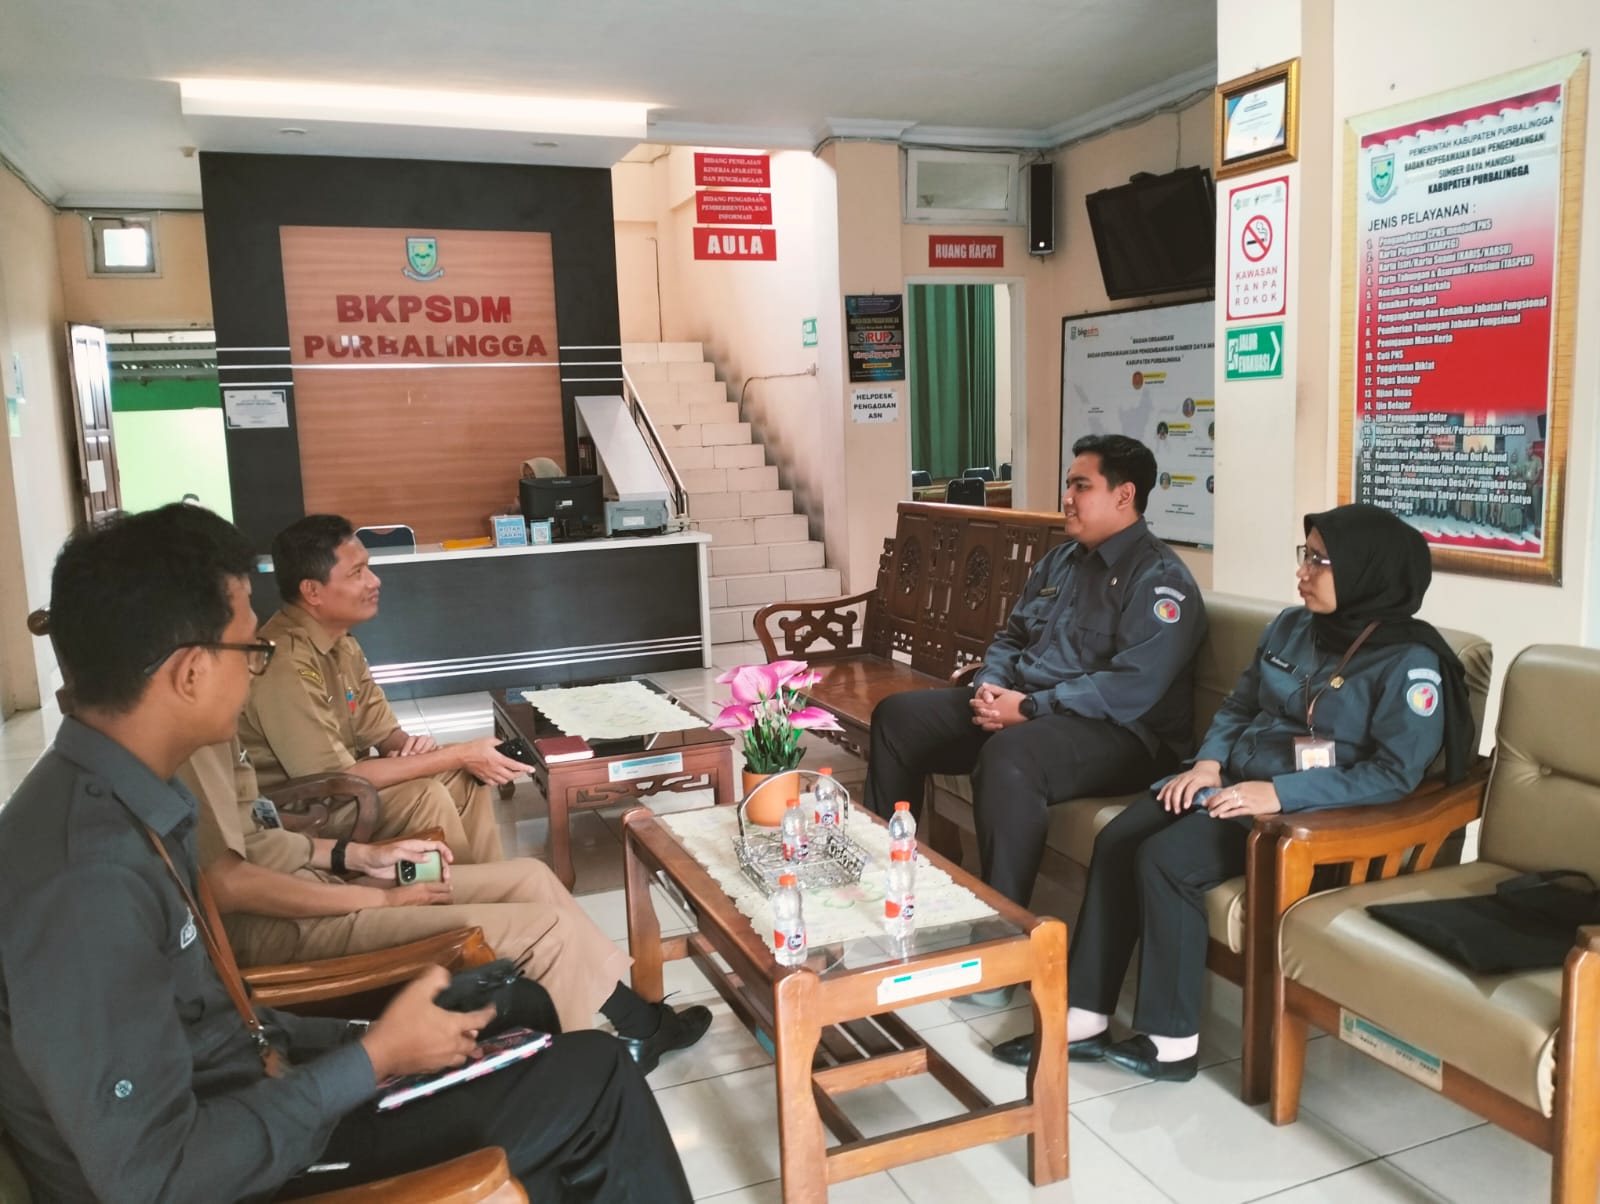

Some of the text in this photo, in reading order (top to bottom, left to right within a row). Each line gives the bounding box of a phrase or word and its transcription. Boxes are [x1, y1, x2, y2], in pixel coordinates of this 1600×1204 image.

[1408, 115, 1554, 156] PEMERINTAH KABUPATEN PURBALINGGA
[1404, 132, 1545, 172] BADAN KEPEGAWAIAN DAN PENGEMBANGAN
[1439, 155, 1515, 178] SUMBER DAYA MANUSIA
[1428, 164, 1529, 194] KABUPATEN PURBALINGGA
[1368, 203, 1469, 232] JENIS PELAYANAN
[1379, 231, 1427, 247] Pengangkatan
[1427, 227, 1446, 239] CPNS
[1446, 222, 1476, 236] menjadi
[1477, 218, 1492, 231] PNS
[707, 234, 764, 255] AULA
[935, 243, 997, 259] RUANG RAPAT
[1379, 249, 1397, 260] Kartu
[1427, 238, 1459, 252] (KARPEG)
[1379, 262, 1397, 272] Kartu
[1456, 243, 1513, 261] (KARIS/KARSU)
[1235, 266, 1278, 280] KAWASAN
[1379, 275, 1397, 285] Kartu
[1397, 270, 1430, 282] Tabungan
[1436, 263, 1468, 277] Asuransi
[1469, 260, 1501, 274] Pensiun
[1501, 254, 1534, 269] (TASPEN)
[1235, 280, 1277, 292] TANPA
[1378, 286, 1409, 298] Kenaikan
[1409, 283, 1423, 294] Gaji
[1424, 280, 1451, 292] Berkala
[1235, 293, 1277, 305] ROKOK
[1378, 300, 1409, 310] Kenaikan
[1409, 296, 1437, 307] Pangkat
[336, 294, 512, 323] BKPSDM
[1378, 311, 1425, 323] Pengangkatan
[1425, 309, 1439, 318] dan
[1440, 305, 1474, 317] Kenaikan
[1474, 303, 1503, 314] Jabatan
[1503, 295, 1547, 310] Fungsional
[1414, 322, 1450, 332] Tunjangan
[1451, 318, 1479, 329] Jabatan
[1480, 313, 1521, 327] Fungsional
[304, 334, 548, 358] PURBALINGGA
[1415, 335, 1433, 345] Masa
[1434, 333, 1453, 344] Kerja
[1377, 351, 1391, 360] Cuti
[1391, 349, 1404, 359] PNS
[1126, 358, 1150, 366] KABUPATEN
[1377, 363, 1414, 373] Pengiriman
[1415, 361, 1435, 371] Diklat
[1377, 376, 1396, 386] Tugas
[1396, 374, 1421, 384] Belajar
[856, 392, 893, 400] HELPDESK
[1376, 388, 1393, 398] Ujian
[1393, 388, 1412, 397] Dinas
[853, 402, 897, 410] PENGADAAN
[1387, 401, 1411, 410] Belajar
[1387, 413, 1428, 423] Penggunaan
[1429, 412, 1447, 422] Gelar
[1393, 426, 1423, 435] Kenaikan
[1424, 425, 1500, 435] Pangkat/Penyesuaian
[1501, 426, 1525, 436] Ijazah
[1376, 439, 1396, 447] Mutasi
[1397, 439, 1420, 447] Pindah
[1421, 439, 1434, 448] PNS
[1375, 451, 1408, 459] Konsultasi
[1409, 451, 1440, 461] Psikologi
[1441, 451, 1454, 460] PNS
[1454, 452, 1469, 461] dan
[1470, 452, 1482, 461] Out
[1483, 452, 1507, 462] Bound
[1375, 463, 1399, 472] Laporan
[1400, 463, 1453, 473] Perkawinan/Ijin
[1454, 465, 1494, 475] Perceraian
[1495, 466, 1510, 476] PNS
[1386, 475, 1423, 485] Pencalonan
[1424, 477, 1448, 486] Kepala
[1448, 478, 1507, 489] Desa/Perangkat
[1507, 480, 1527, 490] Desa
[1375, 487, 1392, 496] Tanda
[1394, 488, 1436, 499] Penghargaan
[1438, 490, 1457, 500] Satya
[1458, 491, 1488, 501] Lencana
[1510, 494, 1531, 505] Satya
[1394, 500, 1413, 510] Tugas
